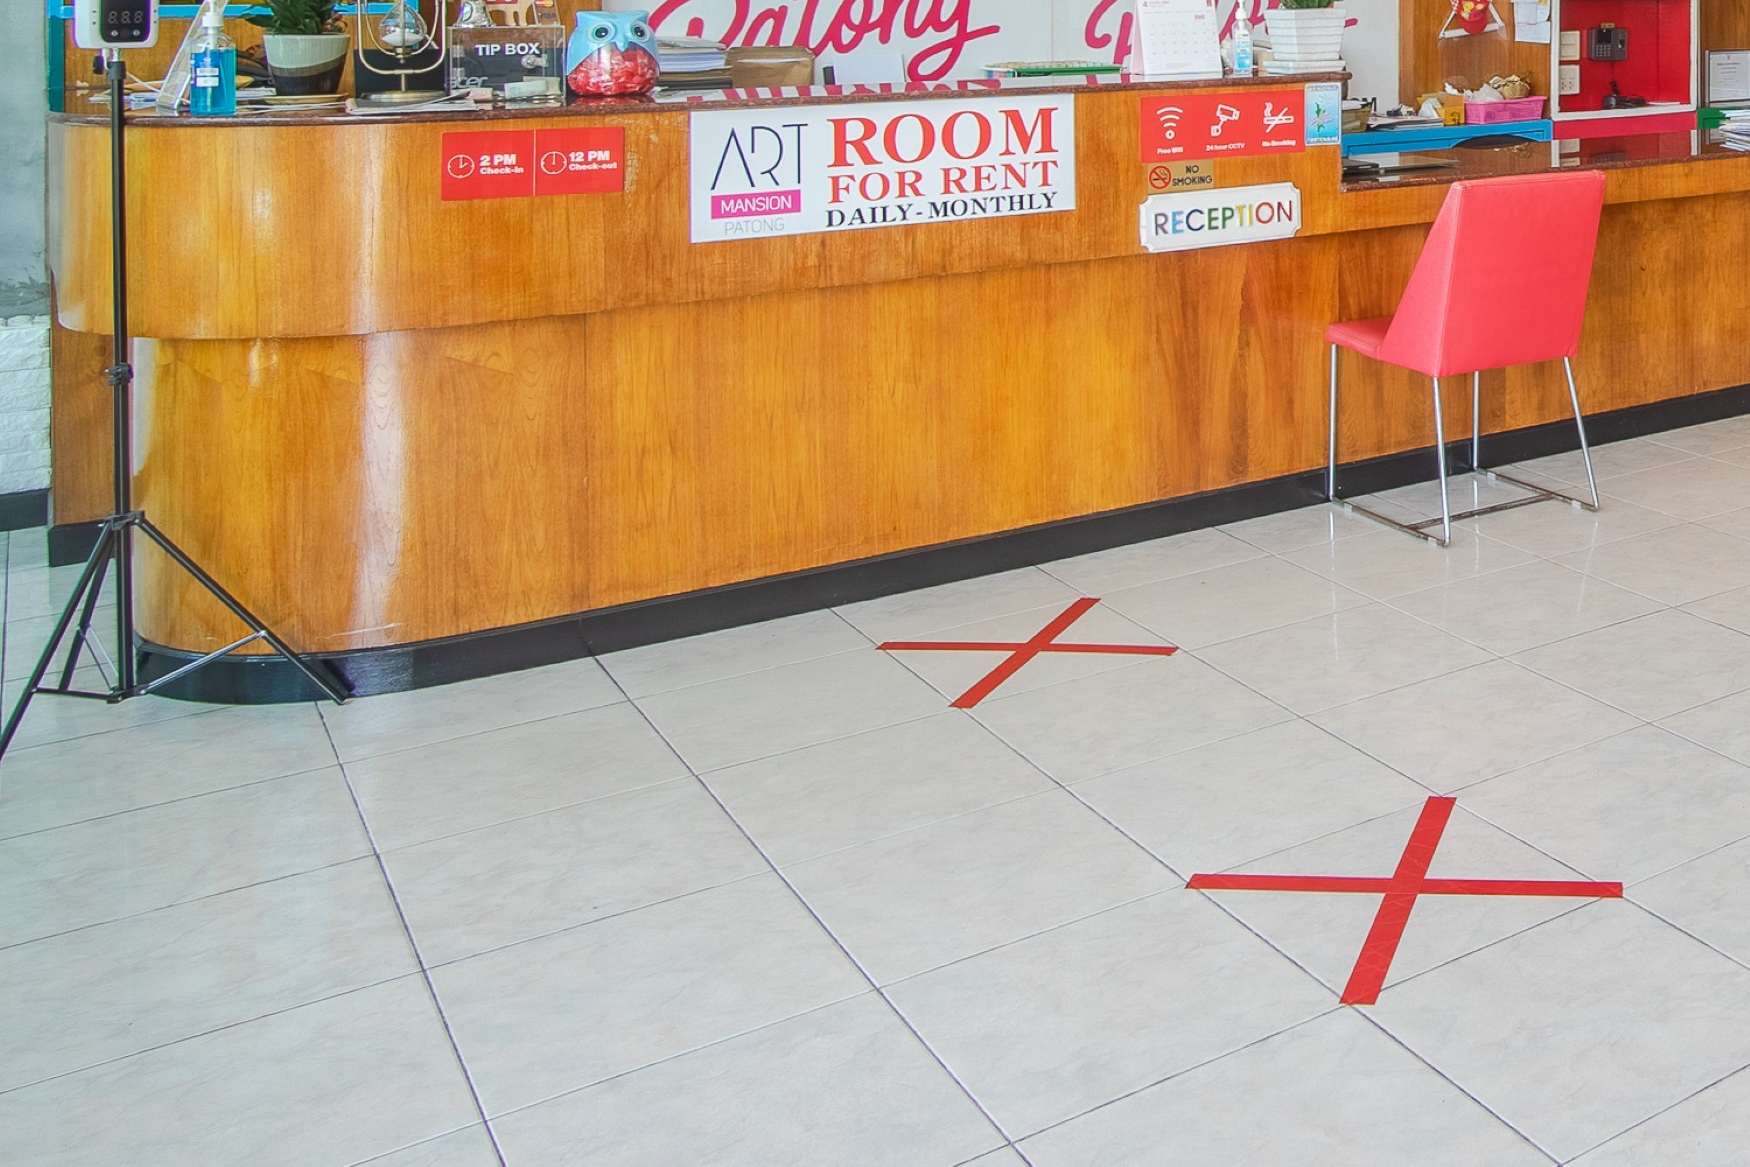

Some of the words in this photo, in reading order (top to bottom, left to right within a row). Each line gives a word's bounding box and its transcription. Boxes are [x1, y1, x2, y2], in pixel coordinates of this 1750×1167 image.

[475, 43, 501, 56] TIP
[505, 42, 541, 55] BOX
[826, 107, 1059, 168] ROOM
[1228, 142, 1246, 150] CCTV
[480, 154, 491, 166] 2
[493, 154, 517, 166] PM
[569, 151, 584, 162] 12
[587, 150, 610, 162] PM
[711, 123, 808, 191] ART
[480, 166, 524, 175] Check-in
[569, 162, 618, 172] Check-out
[1185, 165, 1199, 174] NO
[827, 169, 926, 204] FOR
[940, 160, 1059, 195] RENT
[1172, 175, 1213, 187] SMOKING
[721, 194, 792, 215] MANSION
[1155, 200, 1293, 236] RECEPTION
[724, 218, 785, 236] PATONG
